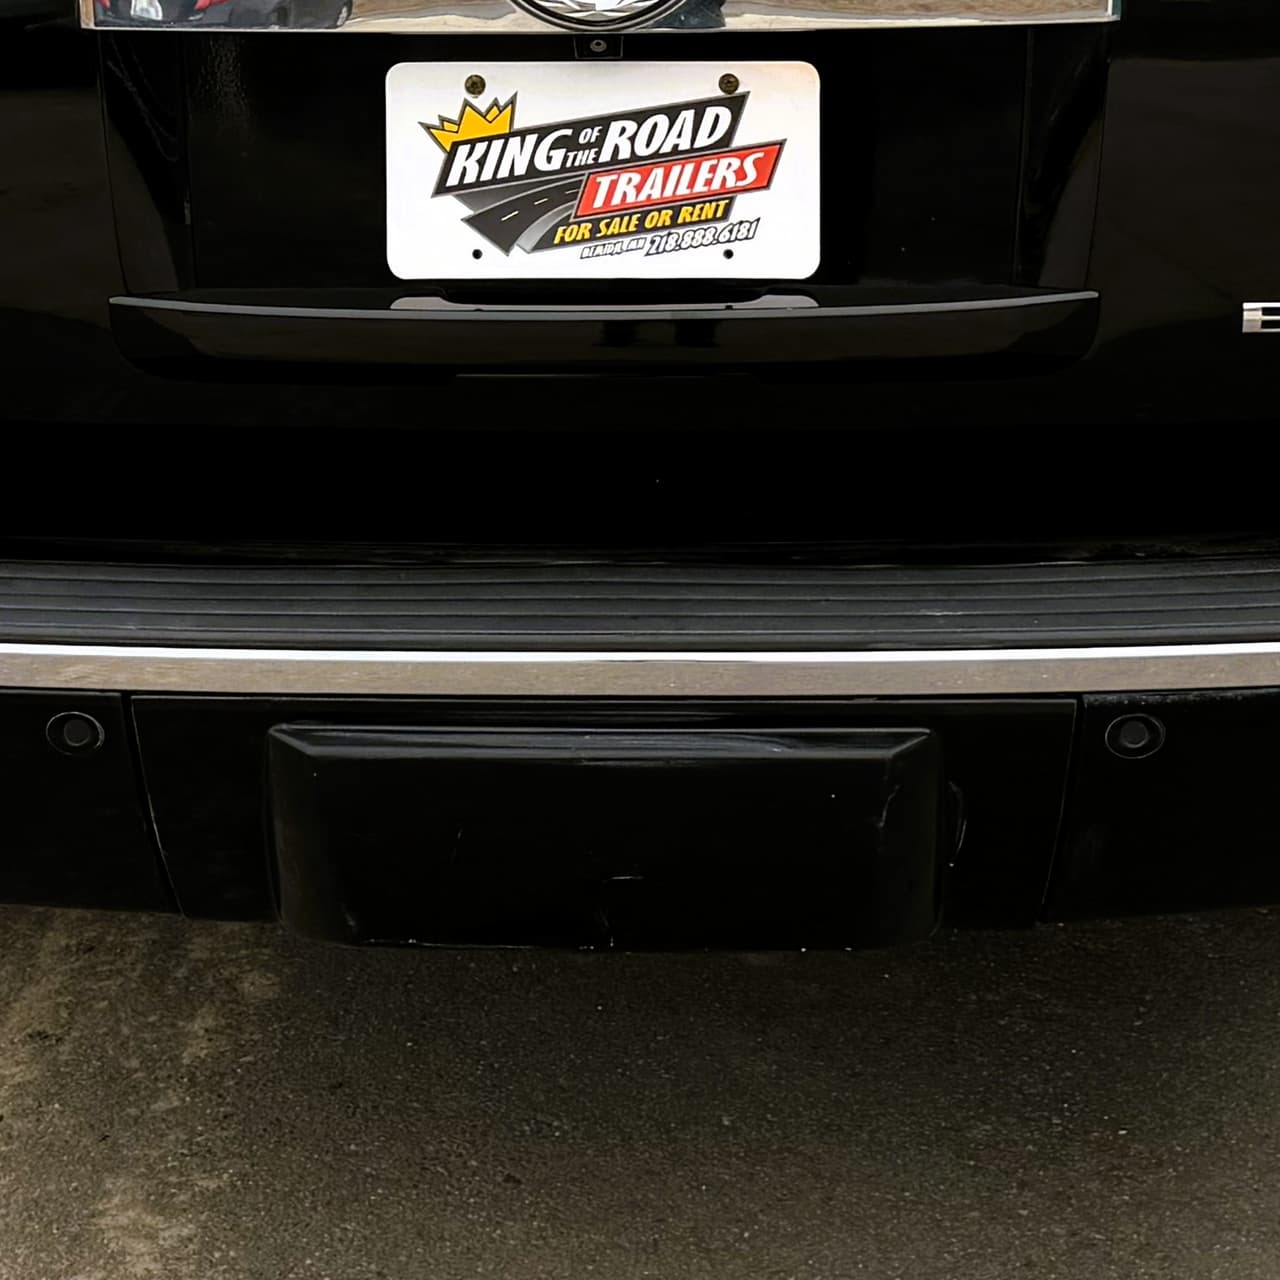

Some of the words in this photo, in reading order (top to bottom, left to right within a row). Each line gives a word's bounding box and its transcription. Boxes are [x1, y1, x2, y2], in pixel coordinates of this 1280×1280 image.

[578, 126, 603, 144] OF
[598, 106, 732, 163] ROAD
[445, 129, 573, 187] KING
[565, 148, 599, 168] THE
[592, 152, 765, 208] TRAILERS
[553, 222, 592, 245] FOR
[596, 213, 641, 237] SALE
[644, 209, 673, 229] OR
[677, 200, 729, 224] RENT
[646, 220, 760, 256] 218.888.6181
